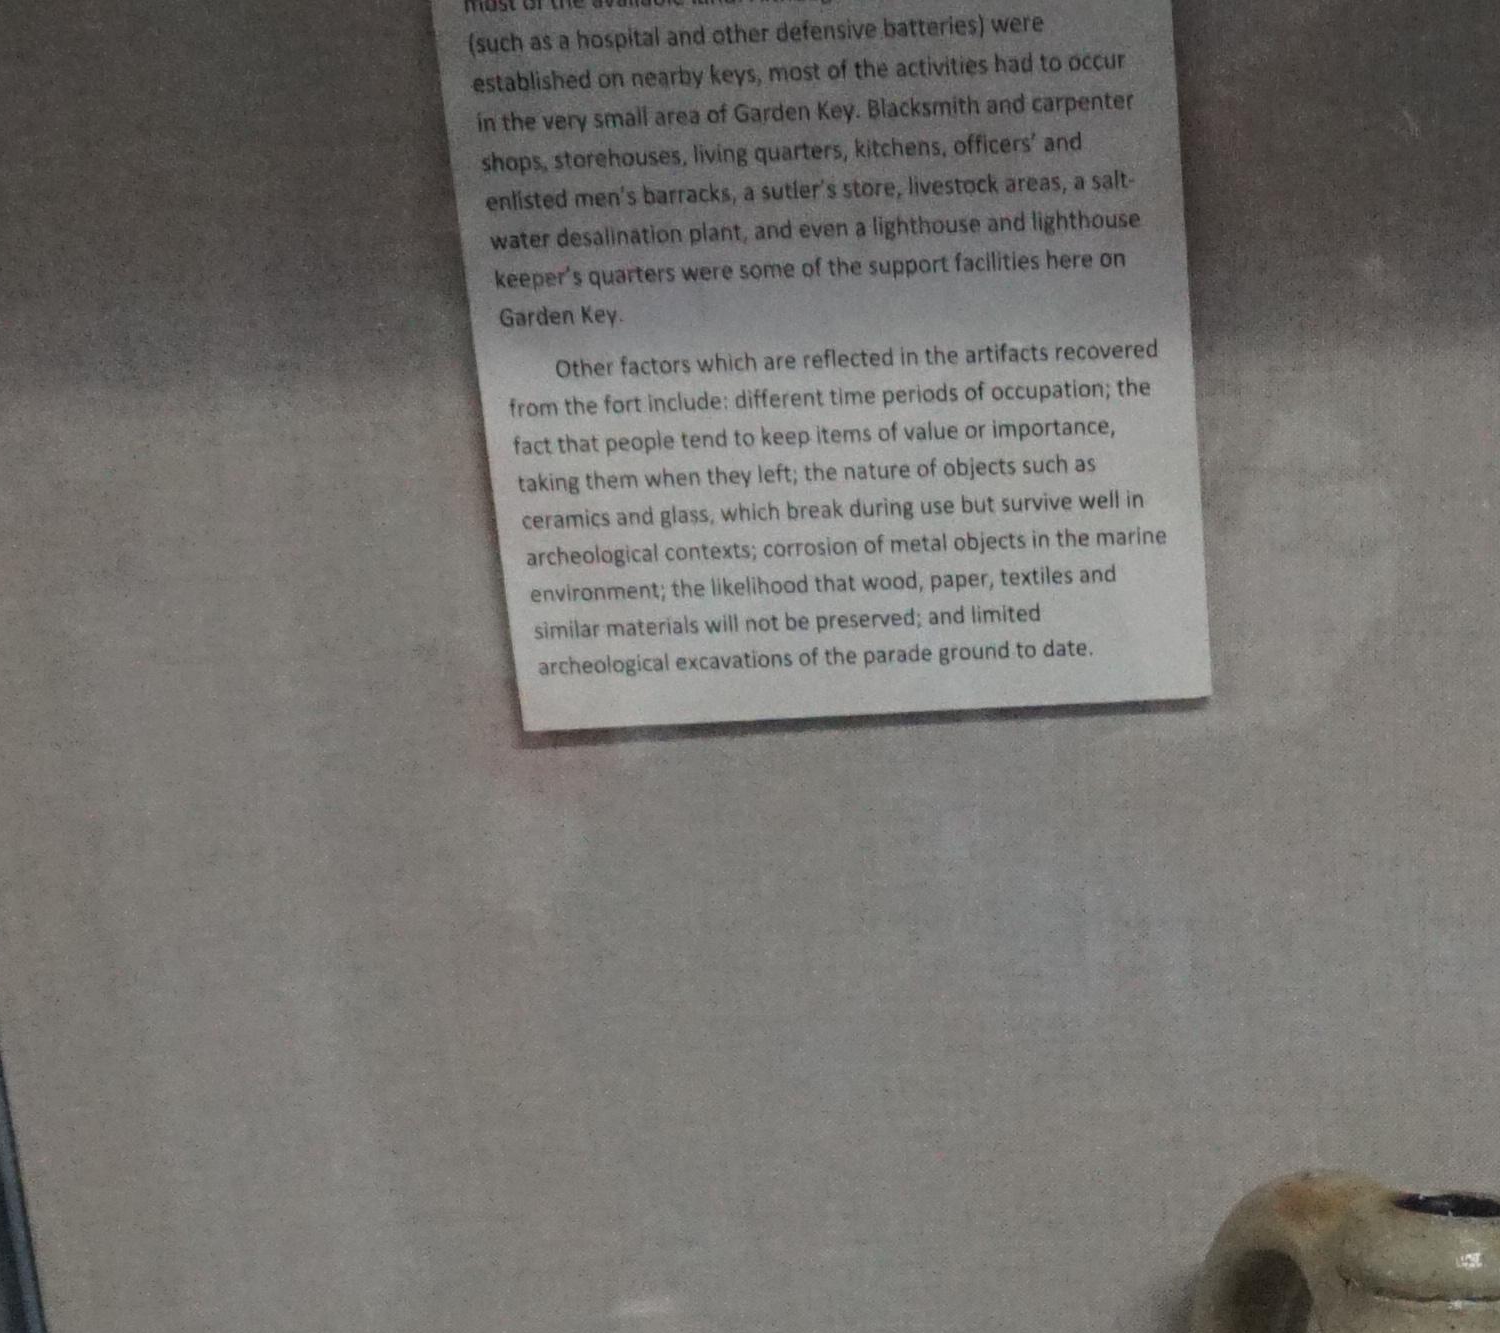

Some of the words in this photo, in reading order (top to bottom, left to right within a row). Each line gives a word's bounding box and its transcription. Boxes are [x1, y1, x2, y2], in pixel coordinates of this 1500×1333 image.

[467, 30, 524, 59] (such
[528, 35, 553, 52] as
[557, 34, 570, 51] a
[575, 25, 660, 53] hospital
[665, 23, 706, 46] and
[711, 21, 769, 44] other
[774, 18, 877, 42] defensive
[881, 12, 985, 39] batteries)
[989, 15, 1045, 33] were
[497, 303, 575, 328] Garden
[579, 303, 622, 329] Key.
[537, 650, 670, 678] archeological
[674, 649, 793, 672] excavations
[797, 645, 819, 667] of
[823, 644, 858, 667] the
[862, 642, 933, 670] parade
[937, 639, 1010, 667] ground
[1014, 641, 1037, 660] to
[1041, 637, 1093, 659] date.
